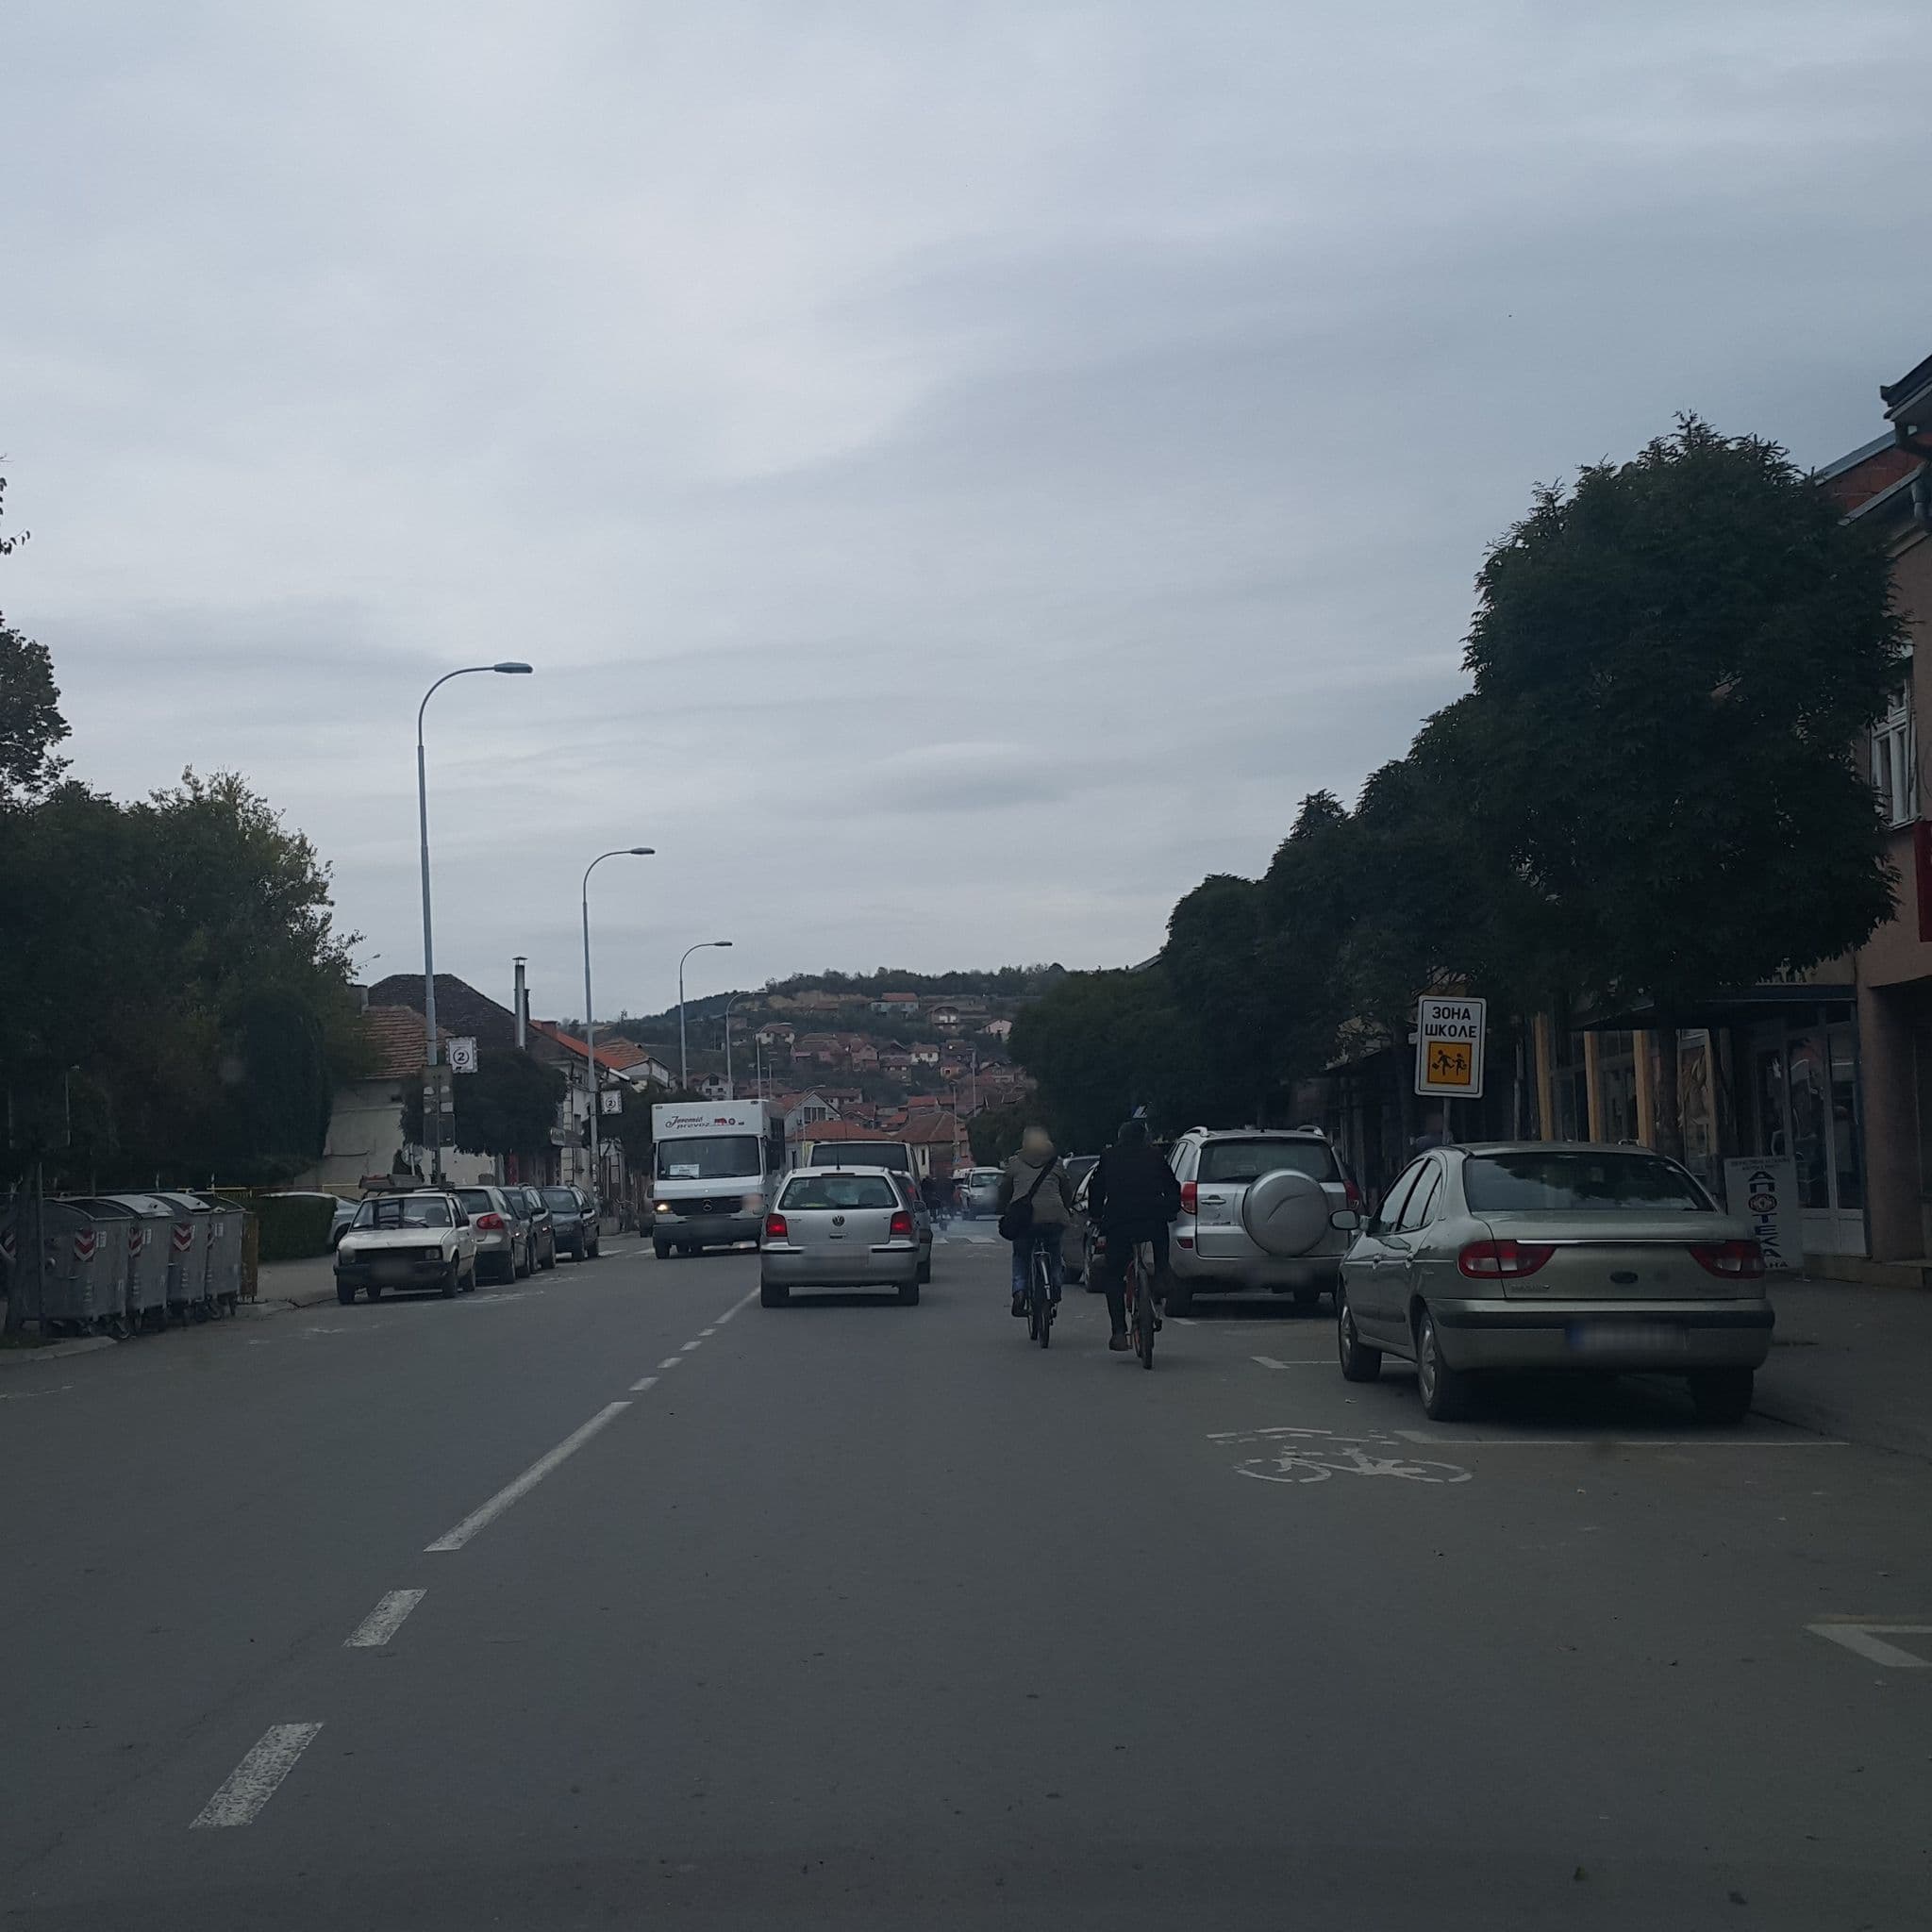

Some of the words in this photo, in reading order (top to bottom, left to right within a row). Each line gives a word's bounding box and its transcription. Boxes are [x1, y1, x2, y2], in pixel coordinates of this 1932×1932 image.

[1431, 1006, 1472, 1021] ЗОНА
[1424, 1024, 1477, 1039] ШКОЛЕ
[457, 1051, 466, 1062] 2
